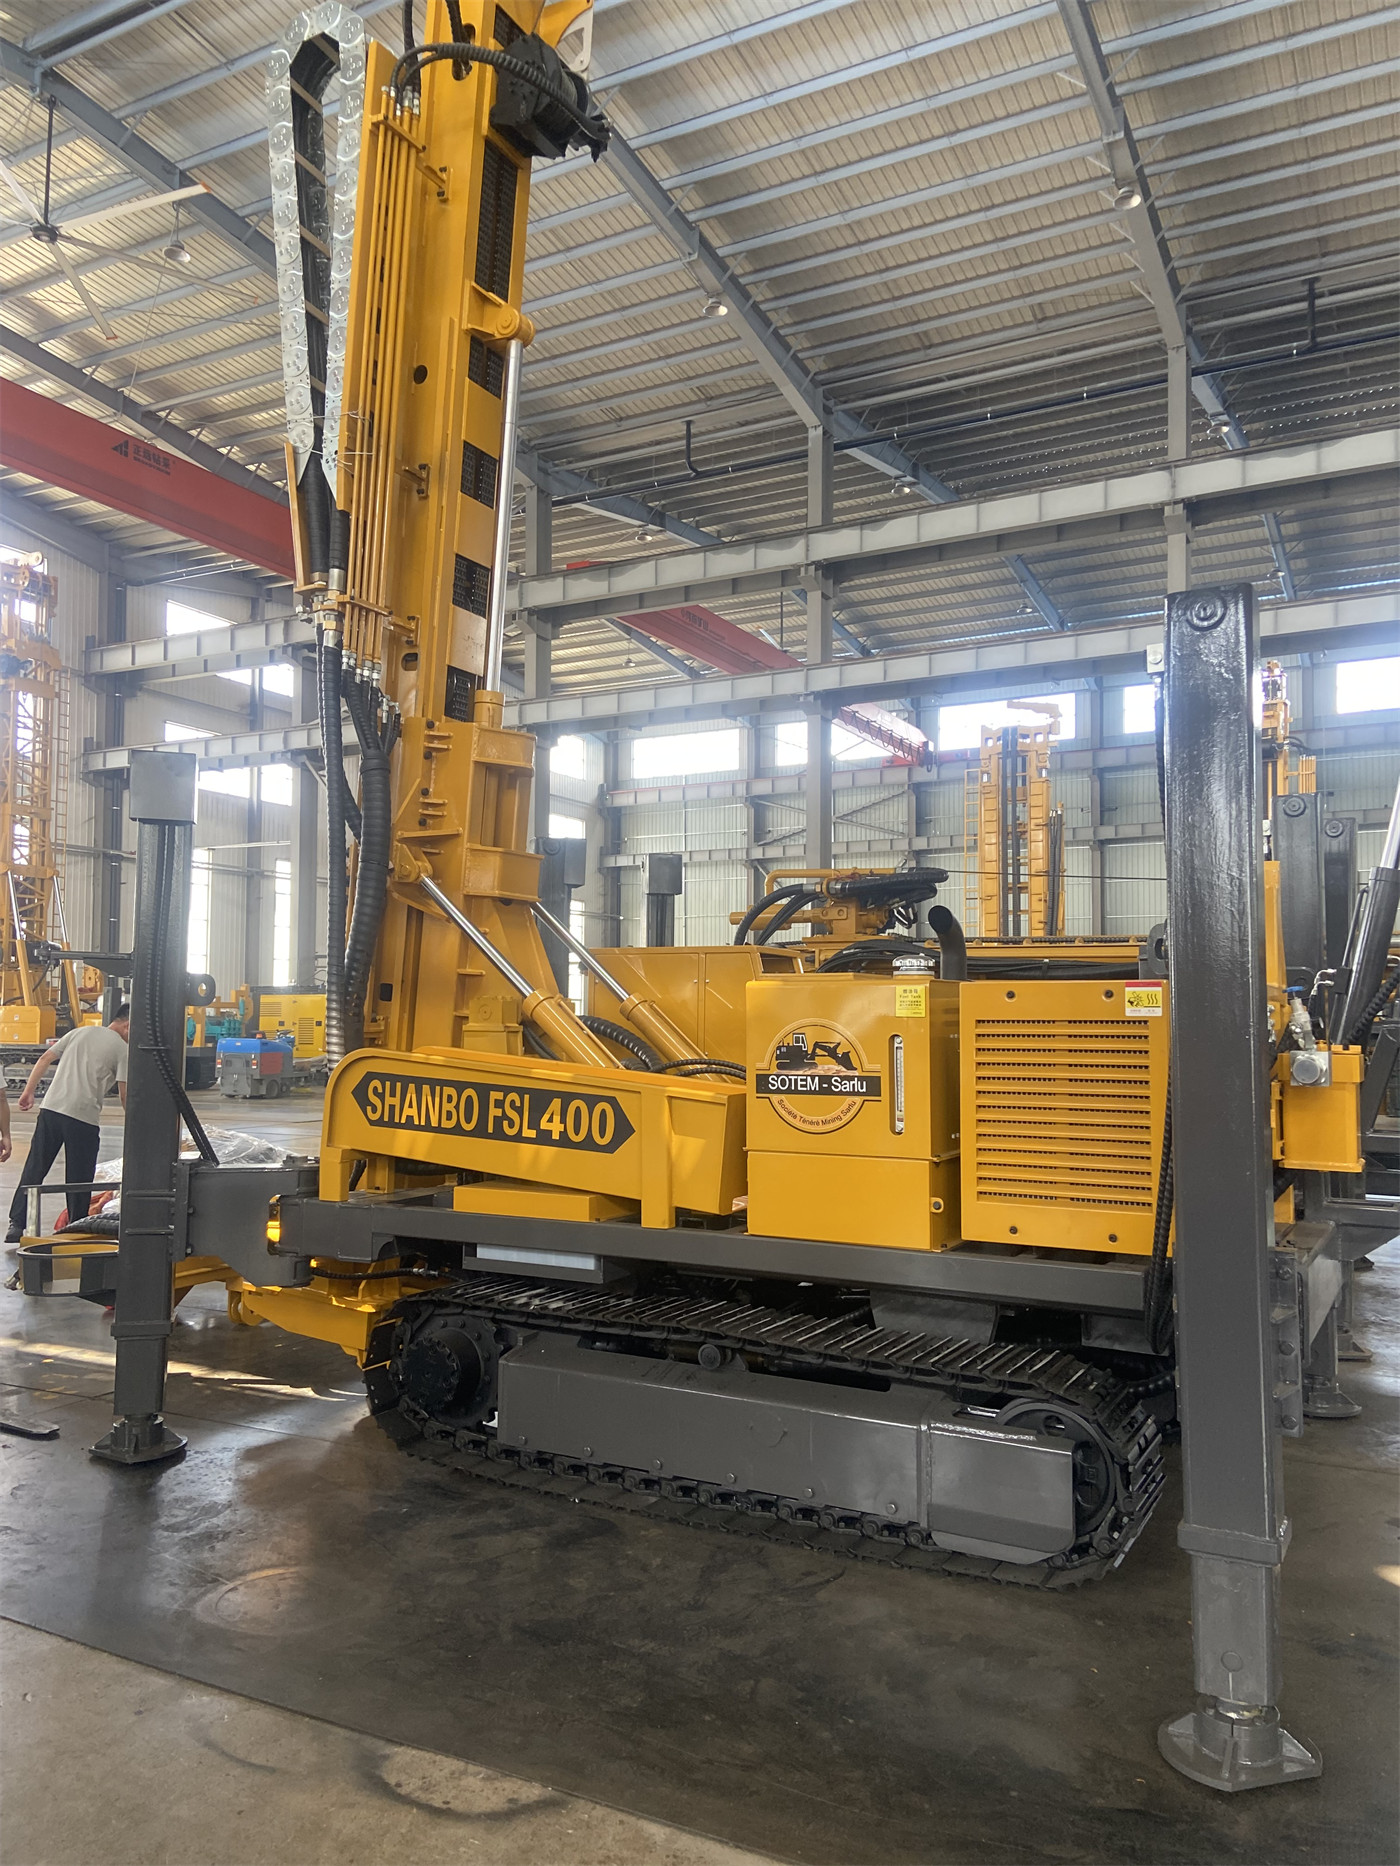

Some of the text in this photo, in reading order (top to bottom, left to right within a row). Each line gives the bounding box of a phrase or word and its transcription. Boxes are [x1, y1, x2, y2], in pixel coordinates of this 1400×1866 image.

[768, 1075, 819, 1091] SOTEM
[831, 1077, 867, 1092] Sarlu
[366, 1079, 479, 1131] SHANBO
[777, 1099, 798, 1120] Société
[821, 1114, 842, 1126] Mining
[841, 1100, 857, 1117] Sarlu
